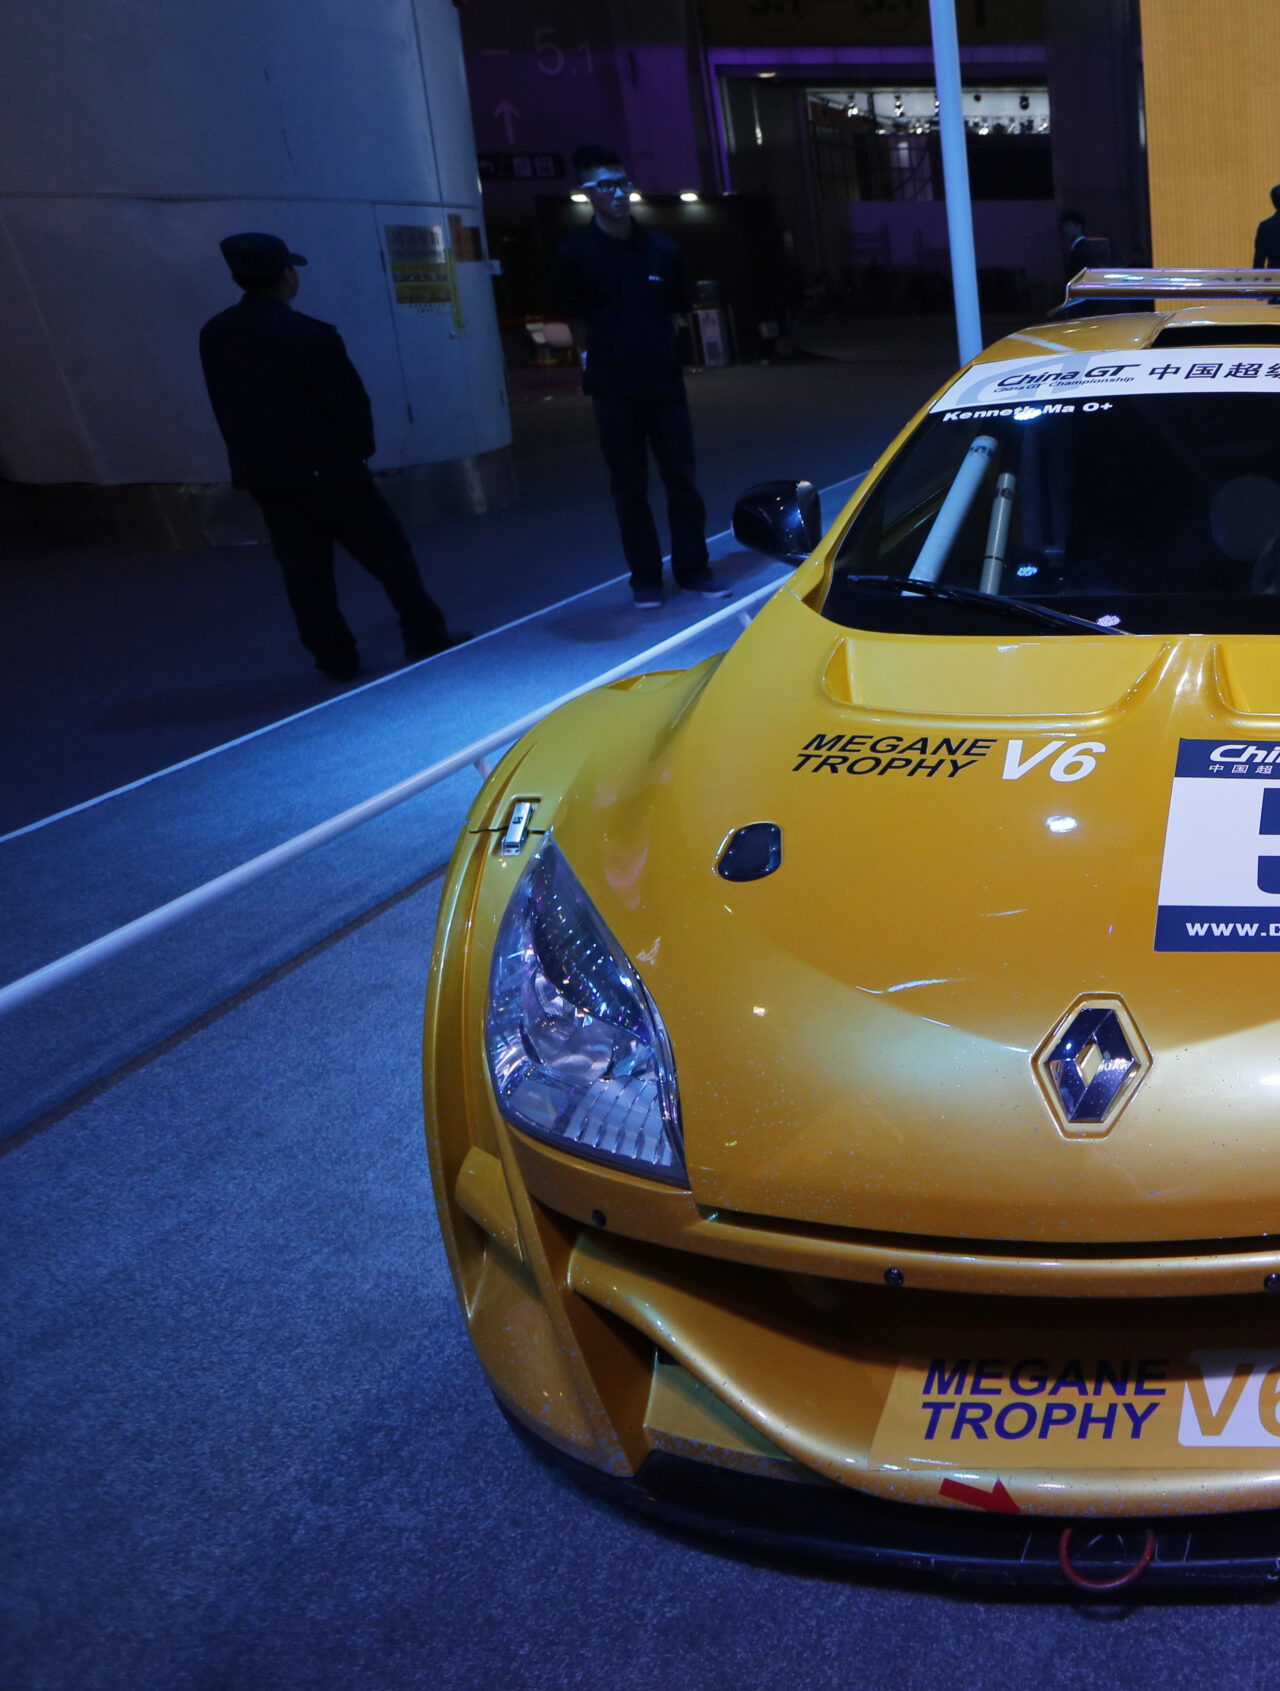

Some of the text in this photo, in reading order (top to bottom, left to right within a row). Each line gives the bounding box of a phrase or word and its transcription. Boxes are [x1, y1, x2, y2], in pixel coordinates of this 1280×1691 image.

[993, 384, 1025, 393] China
[1049, 376, 1135, 387] Championship
[997, 363, 1143, 387] China GT
[1043, 403, 1075, 414] Ma
[802, 733, 998, 756] MEGANE
[792, 753, 979, 778] TROPHY
[1001, 739, 1106, 782] V6
[921, 1358, 1171, 1397] MEGANE
[921, 1401, 1161, 1440] TROPHY
